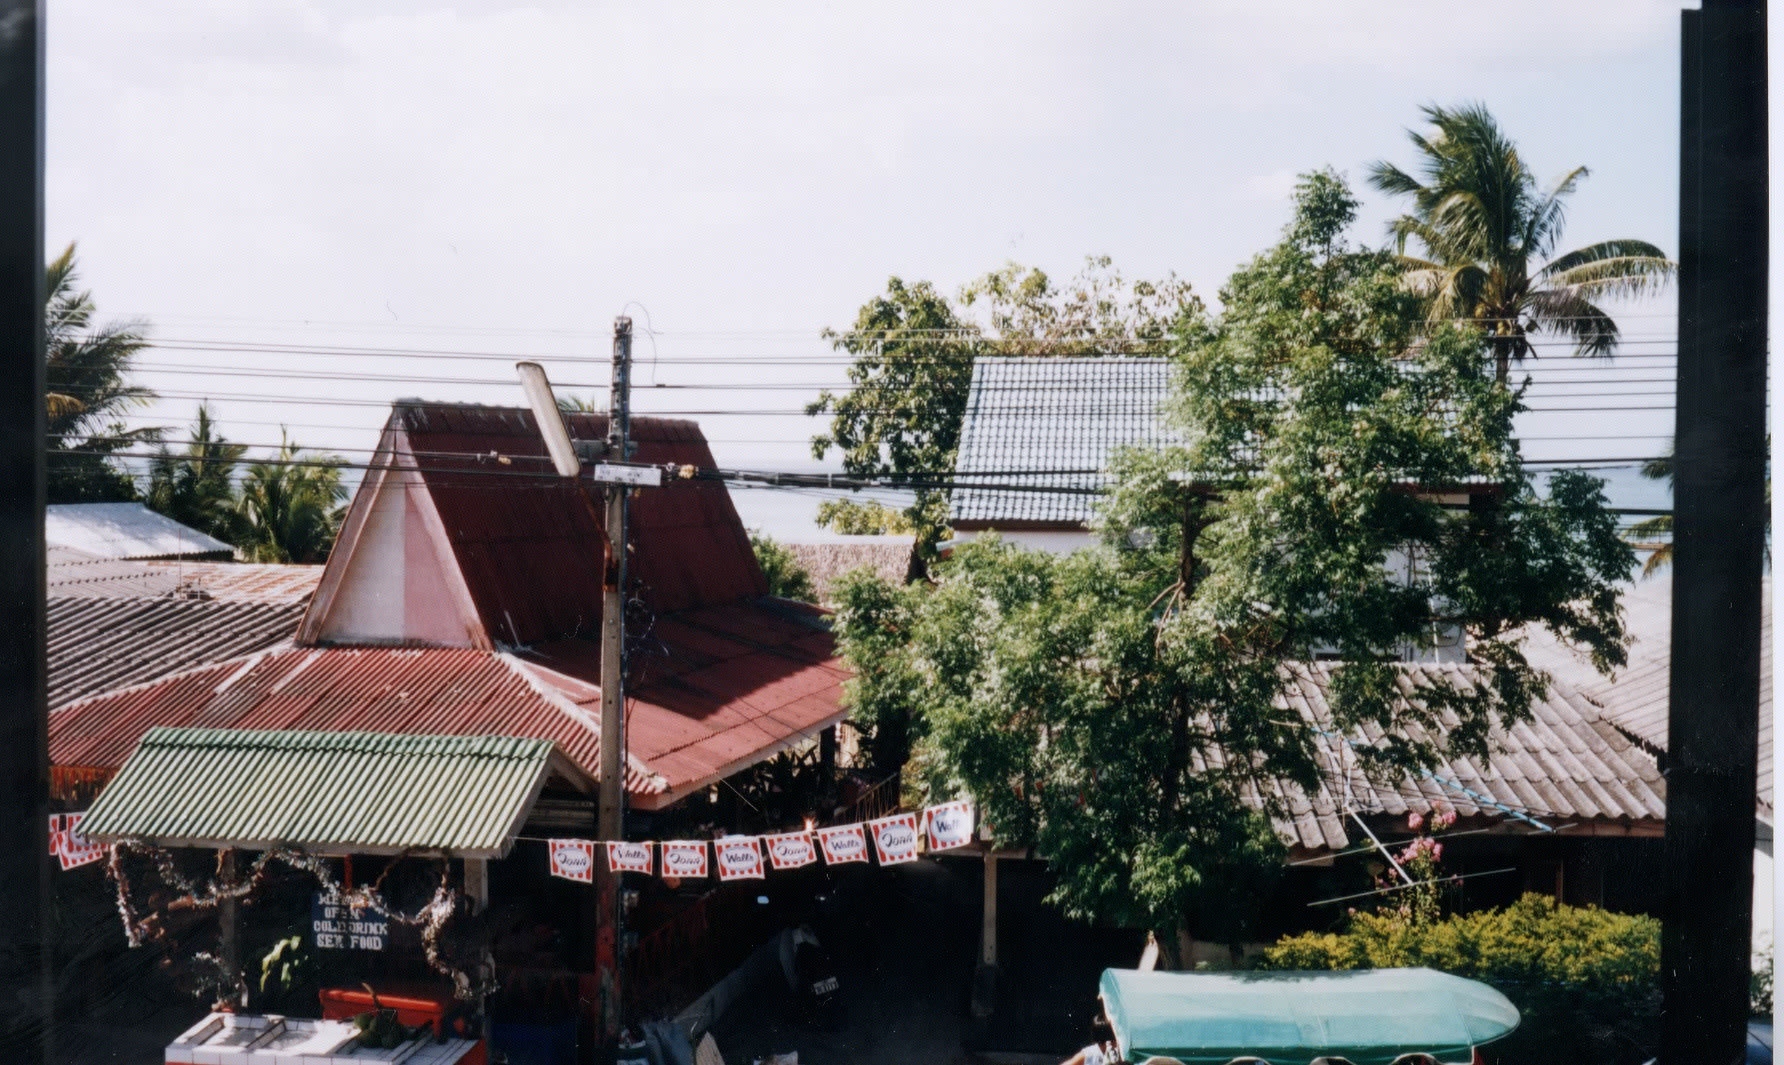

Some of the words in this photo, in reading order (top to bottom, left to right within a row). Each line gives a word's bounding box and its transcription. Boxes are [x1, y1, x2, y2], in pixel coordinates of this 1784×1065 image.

[313, 920, 346, 934] COLD
[348, 922, 388, 936] DRINK
[350, 935, 383, 951] FOOD
